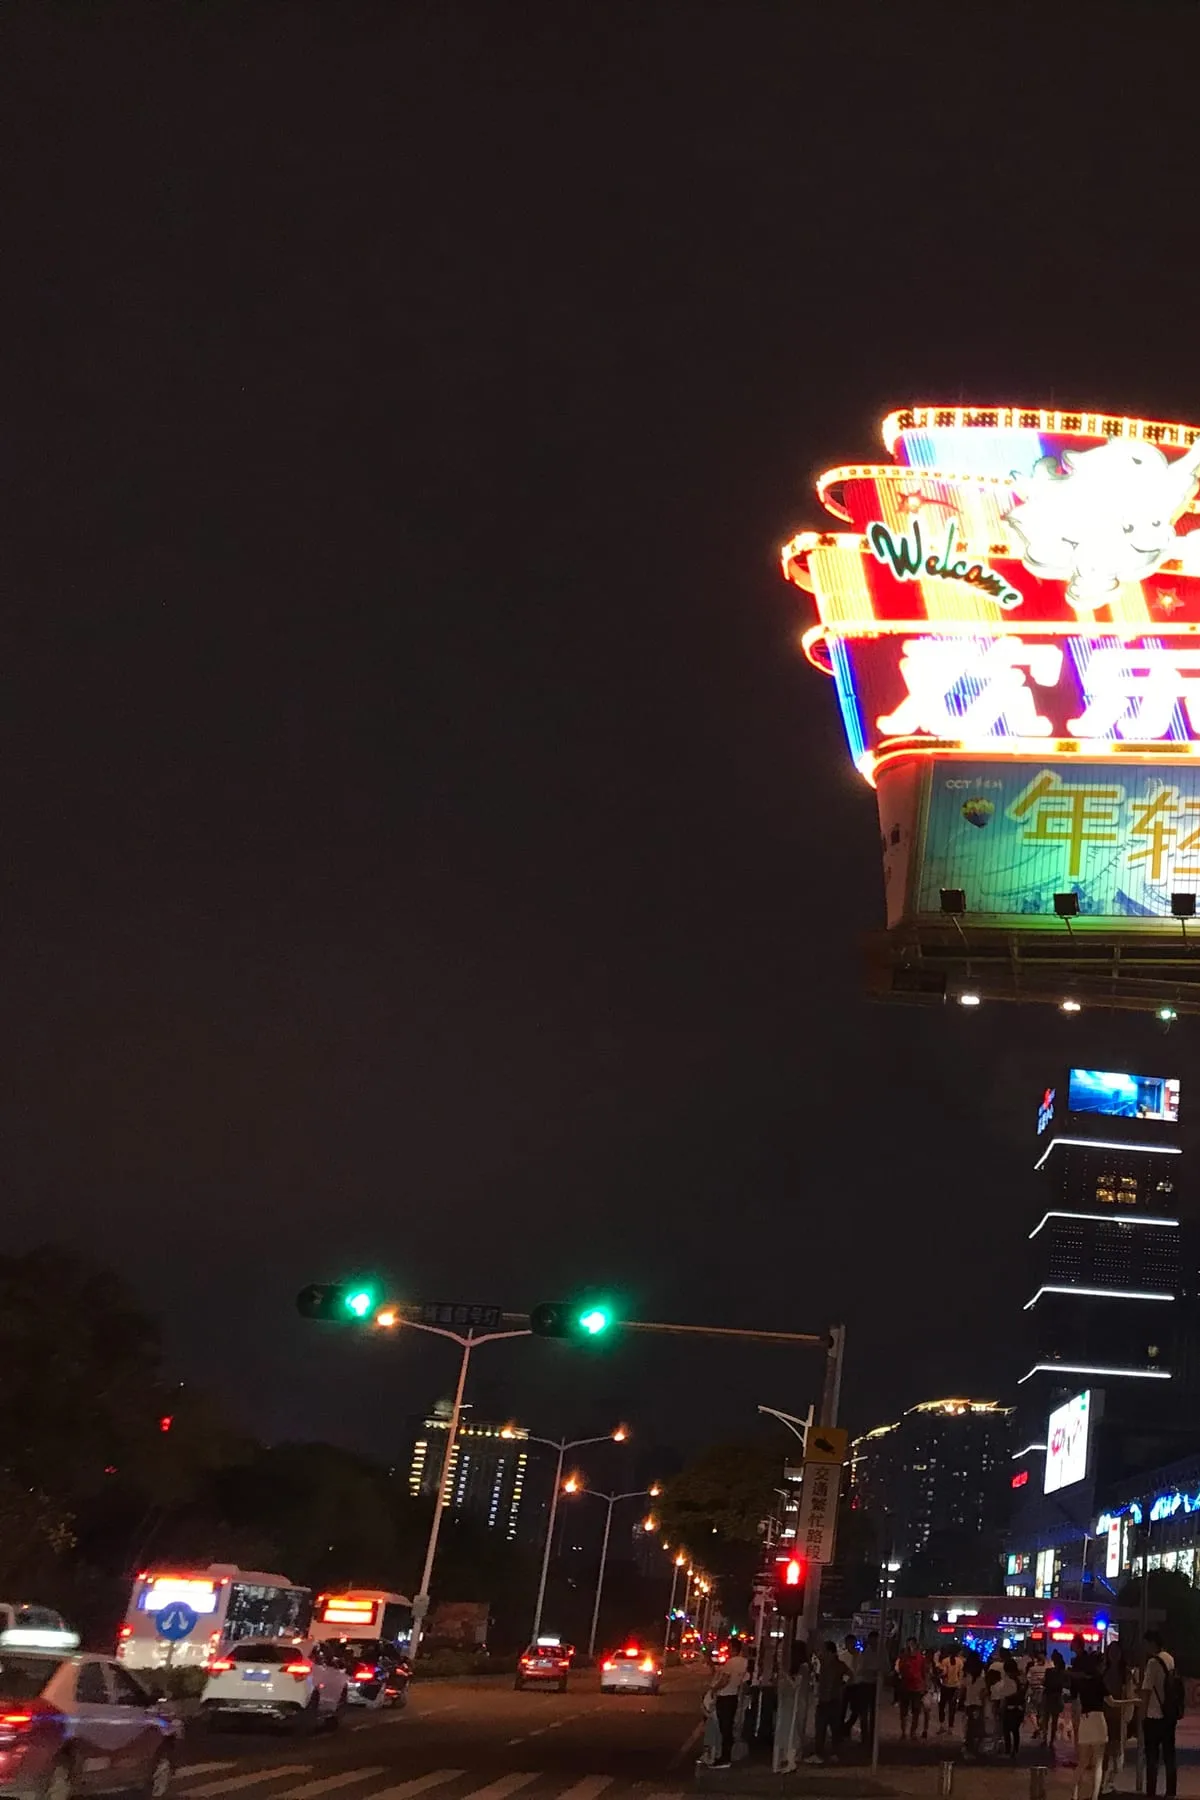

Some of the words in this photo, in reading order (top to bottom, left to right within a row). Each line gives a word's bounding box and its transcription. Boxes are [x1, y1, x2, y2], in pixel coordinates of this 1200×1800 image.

[871, 519, 1019, 605] Welcome
[805, 1465, 832, 1560] 交通繁忙路段
